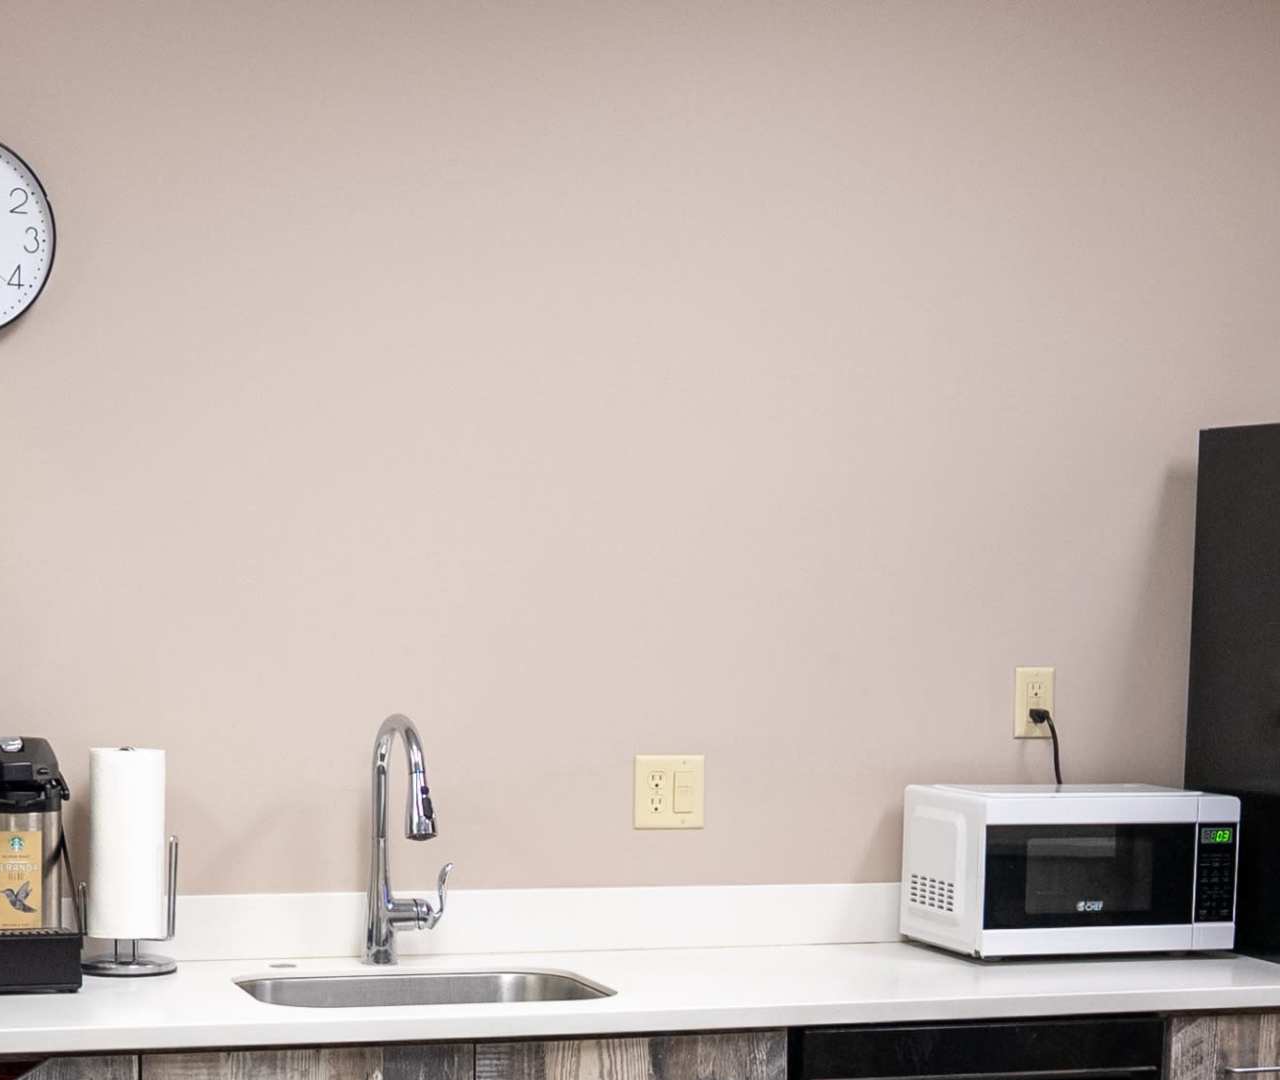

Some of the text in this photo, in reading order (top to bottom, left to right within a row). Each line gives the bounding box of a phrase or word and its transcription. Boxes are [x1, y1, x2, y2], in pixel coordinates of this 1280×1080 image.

[9, 188, 29, 215] 2
[24, 227, 40, 254] 3
[7, 264, 24, 290] 4
[1086, 900, 1104, 911] CHEF
